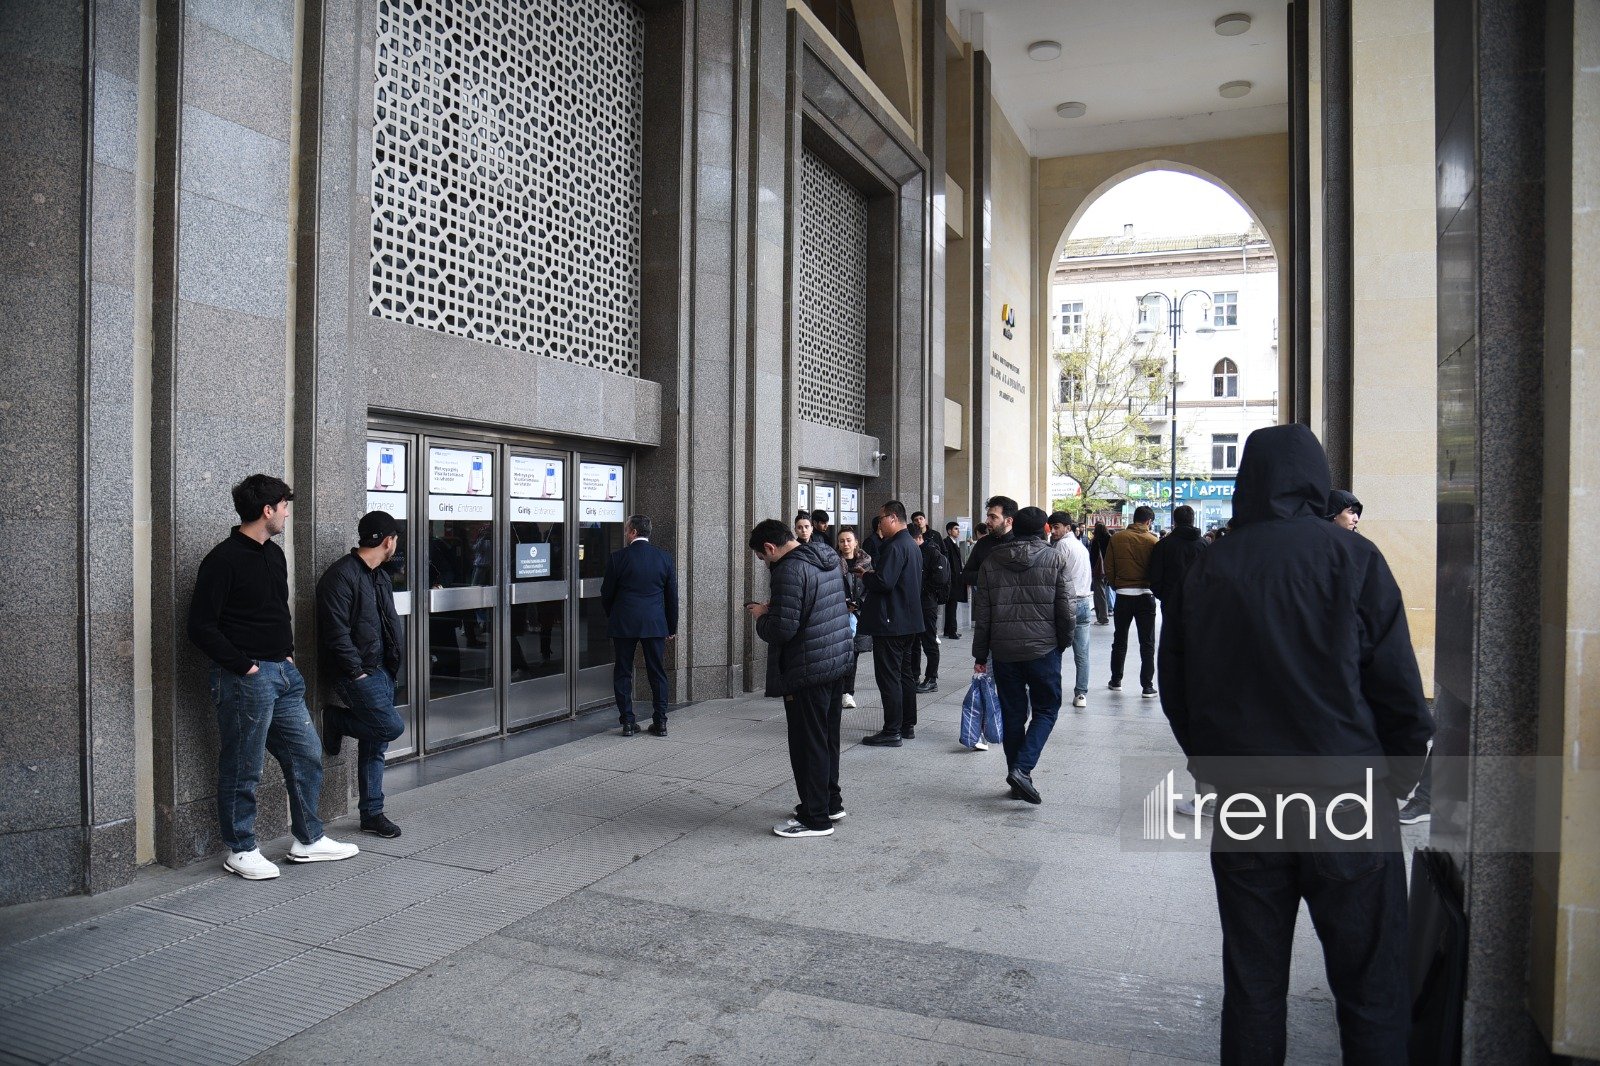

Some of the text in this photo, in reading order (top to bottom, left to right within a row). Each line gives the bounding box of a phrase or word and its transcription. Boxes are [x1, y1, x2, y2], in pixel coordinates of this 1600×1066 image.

[367, 501, 395, 511] ntrance
[438, 503, 483, 514] Giriş Entrance
[517, 506, 531, 516] Giriş
